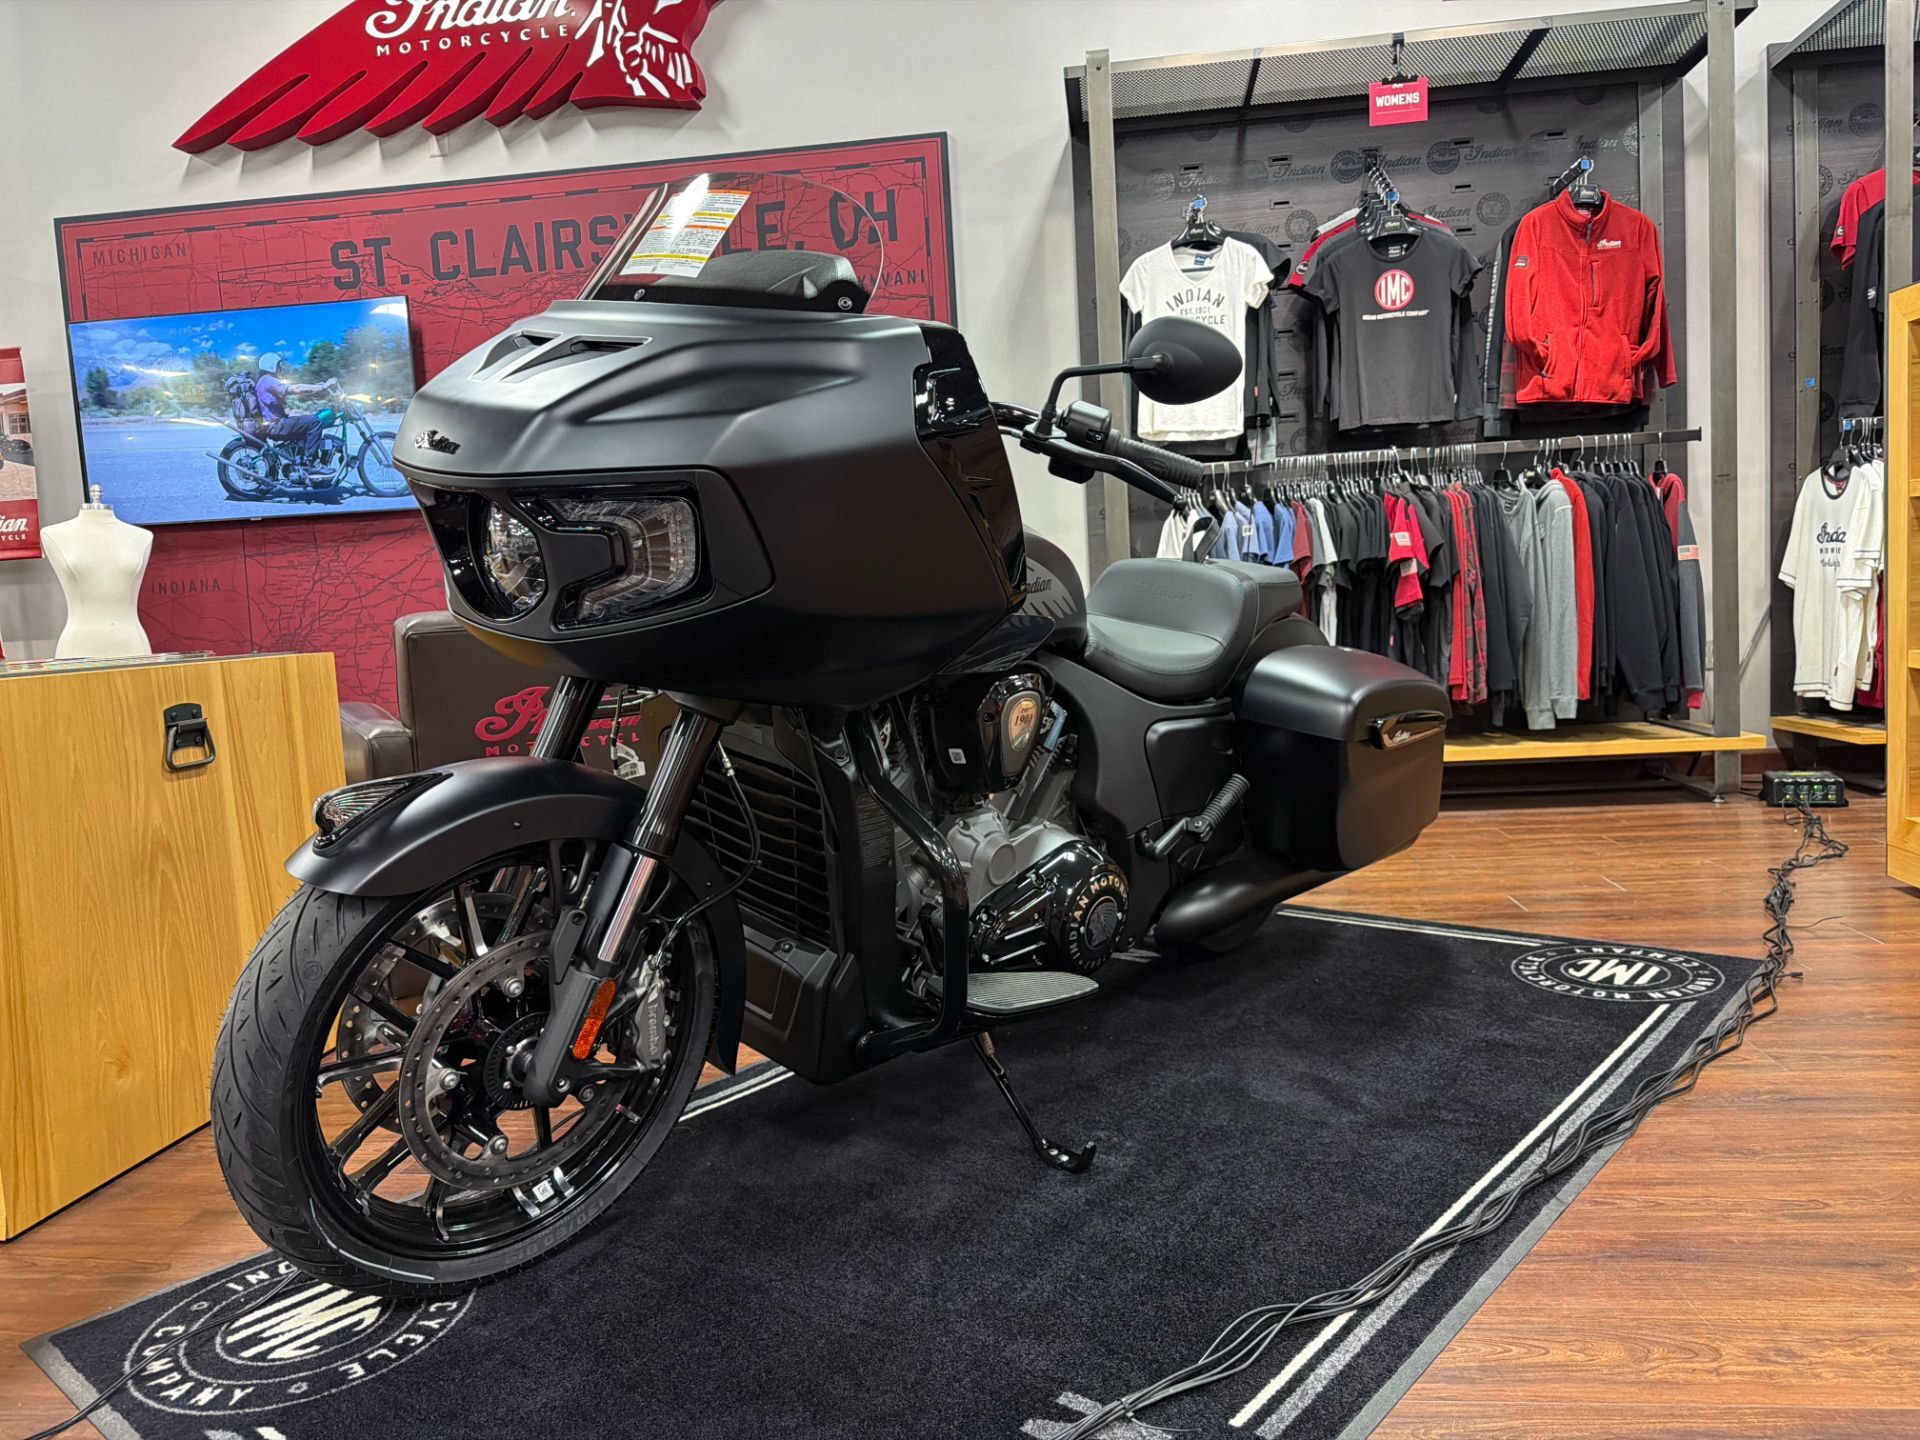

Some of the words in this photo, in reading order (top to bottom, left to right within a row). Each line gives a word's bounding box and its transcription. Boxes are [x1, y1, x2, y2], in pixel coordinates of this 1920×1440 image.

[376, 24, 568, 57] MOTORCYCLE
[1375, 92, 1420, 107] WOMENS
[93, 242, 187, 266] MICHIGAN
[329, 237, 410, 290] ST.
[829, 189, 898, 250] OH
[1166, 287, 1225, 311] INDIAN
[1380, 273, 1410, 306] IMC
[151, 577, 222, 596] INDIANA
[1518, 954, 1631, 1000] MOTORCYCLE
[1568, 958, 1661, 986] IMC
[1648, 977, 1716, 999] INDIAN
[648, 1003, 660, 1055] brembo
[225, 1283, 383, 1360] IMC
[142, 1325, 255, 1407] COMPANY
